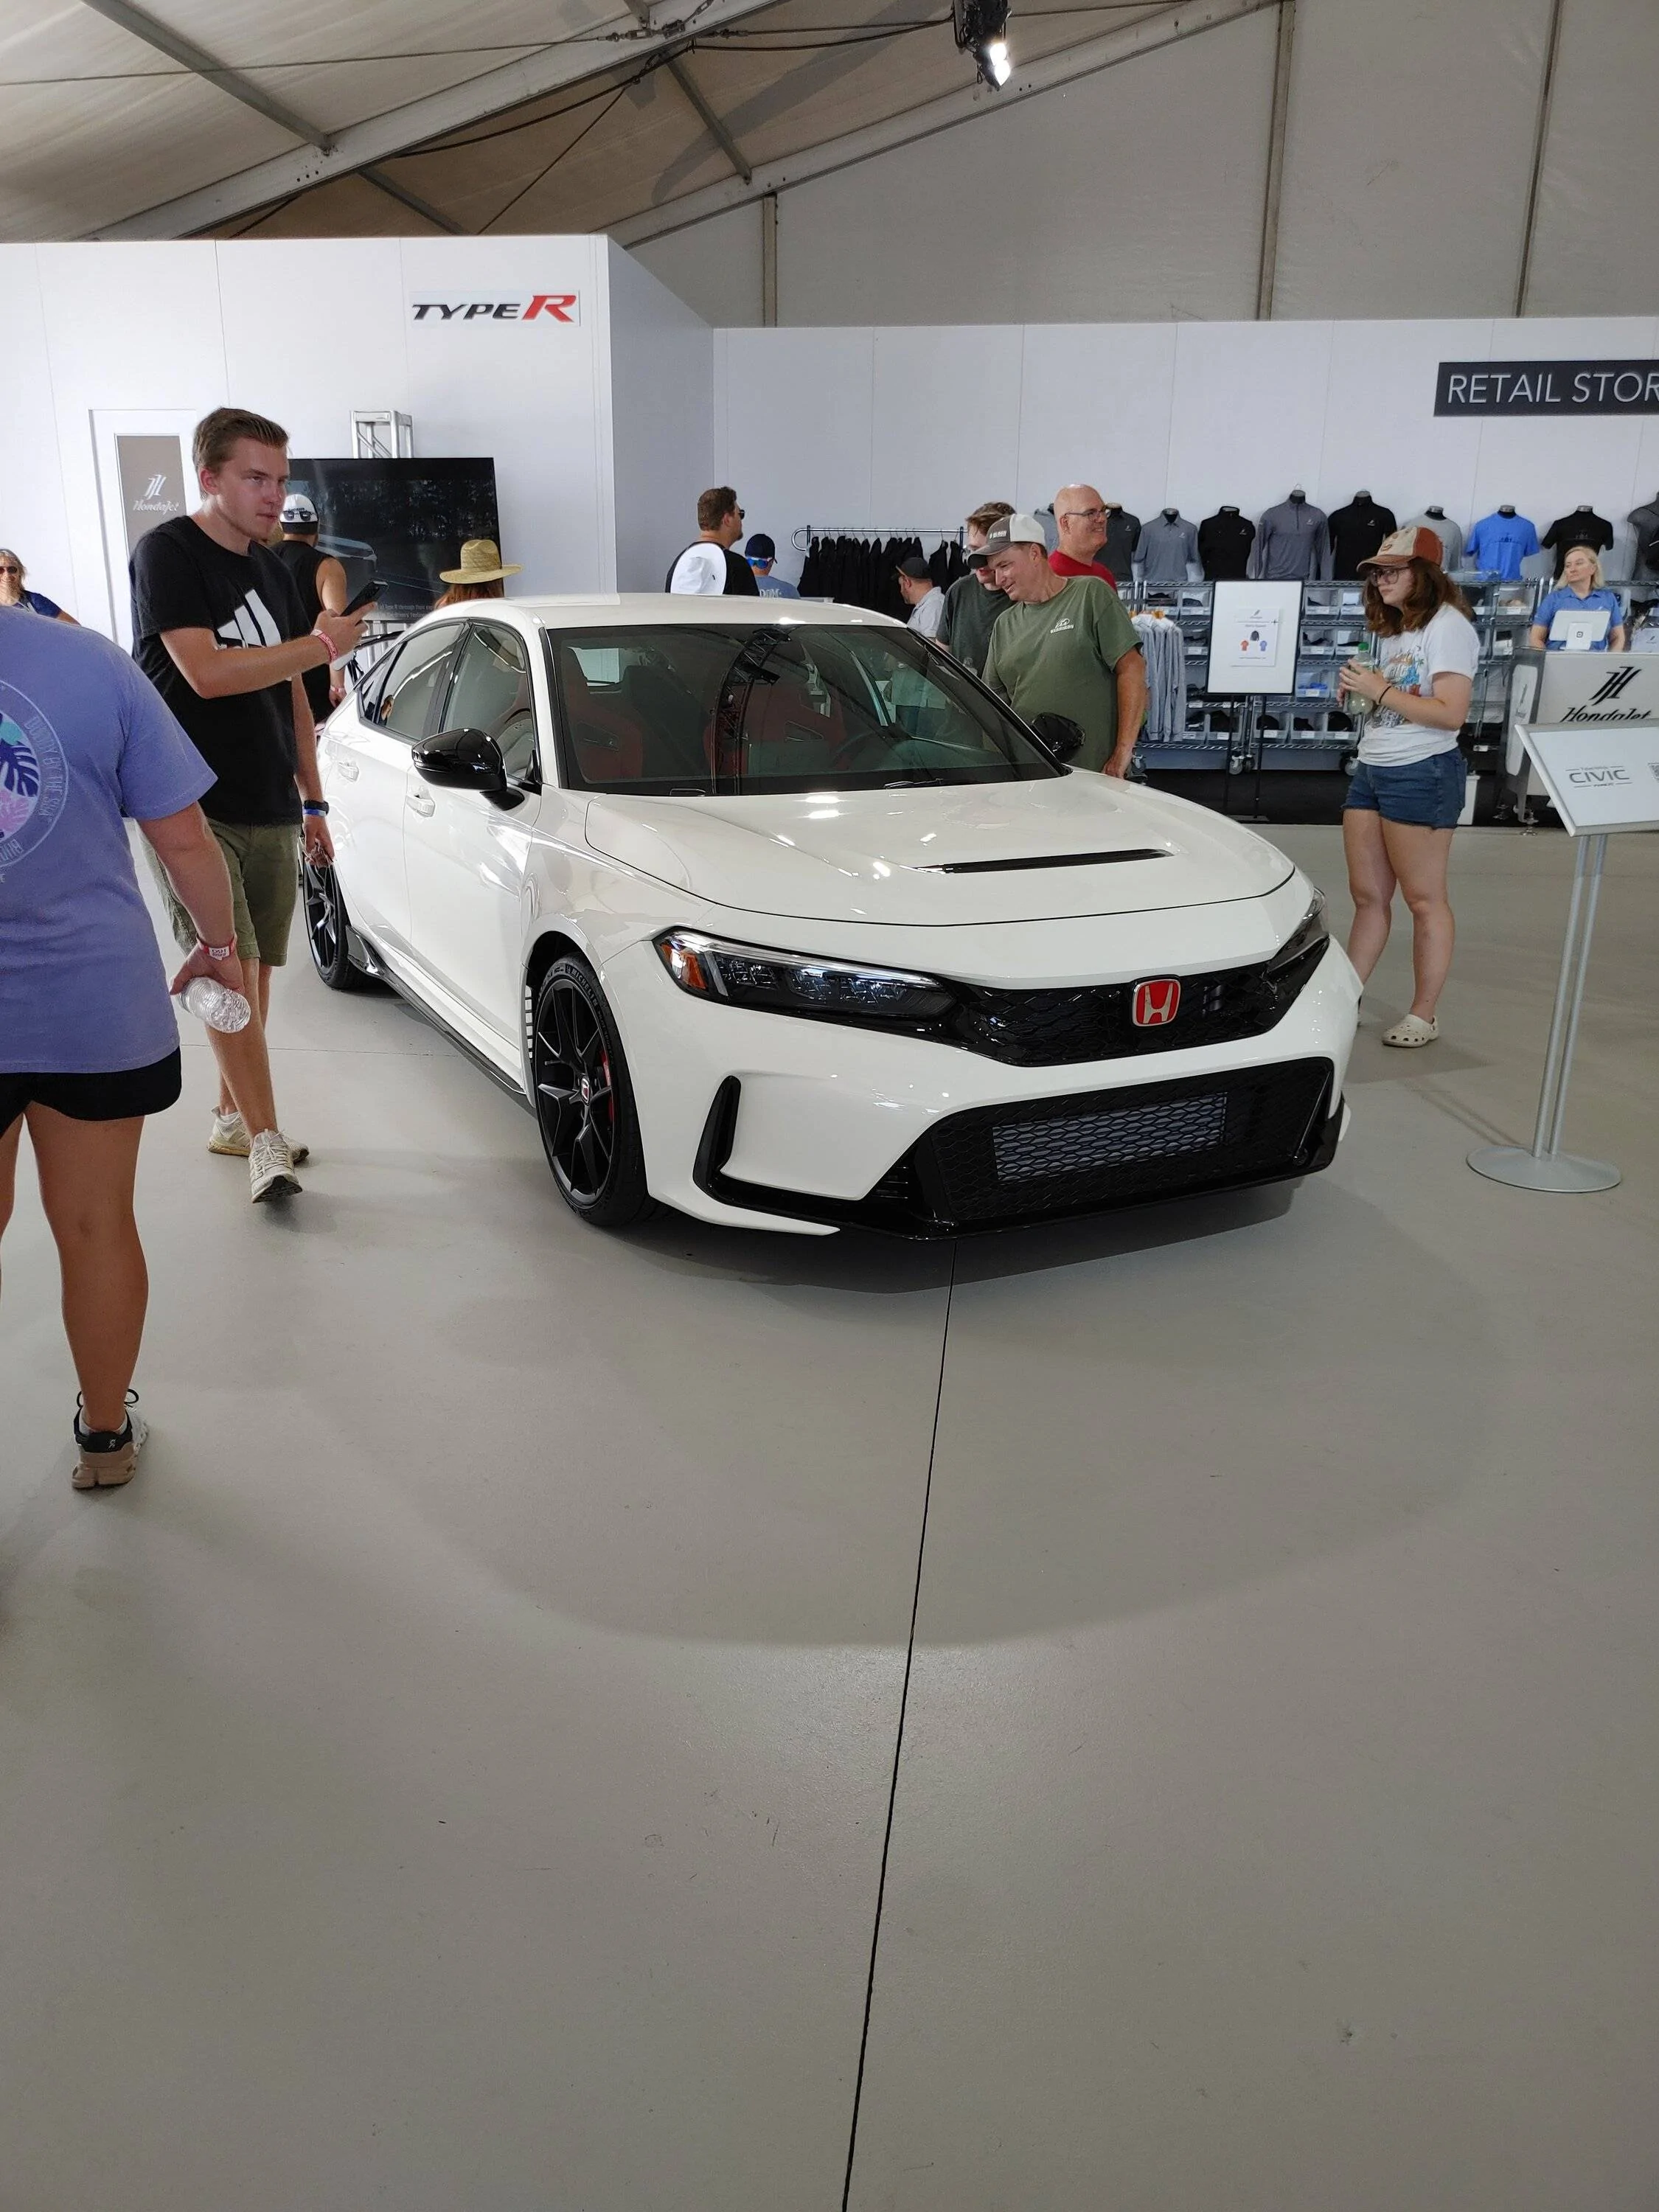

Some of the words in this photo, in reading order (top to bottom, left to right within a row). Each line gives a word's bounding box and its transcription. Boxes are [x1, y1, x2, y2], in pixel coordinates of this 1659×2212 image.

[412, 303, 521, 320] TYPE
[521, 295, 577, 322] R
[1447, 374, 1561, 403] RETAIL
[1559, 705, 1652, 723] HondaJet
[1569, 770, 1630, 783] CIVIC
[571, 968, 598, 1006] MICHELIN
